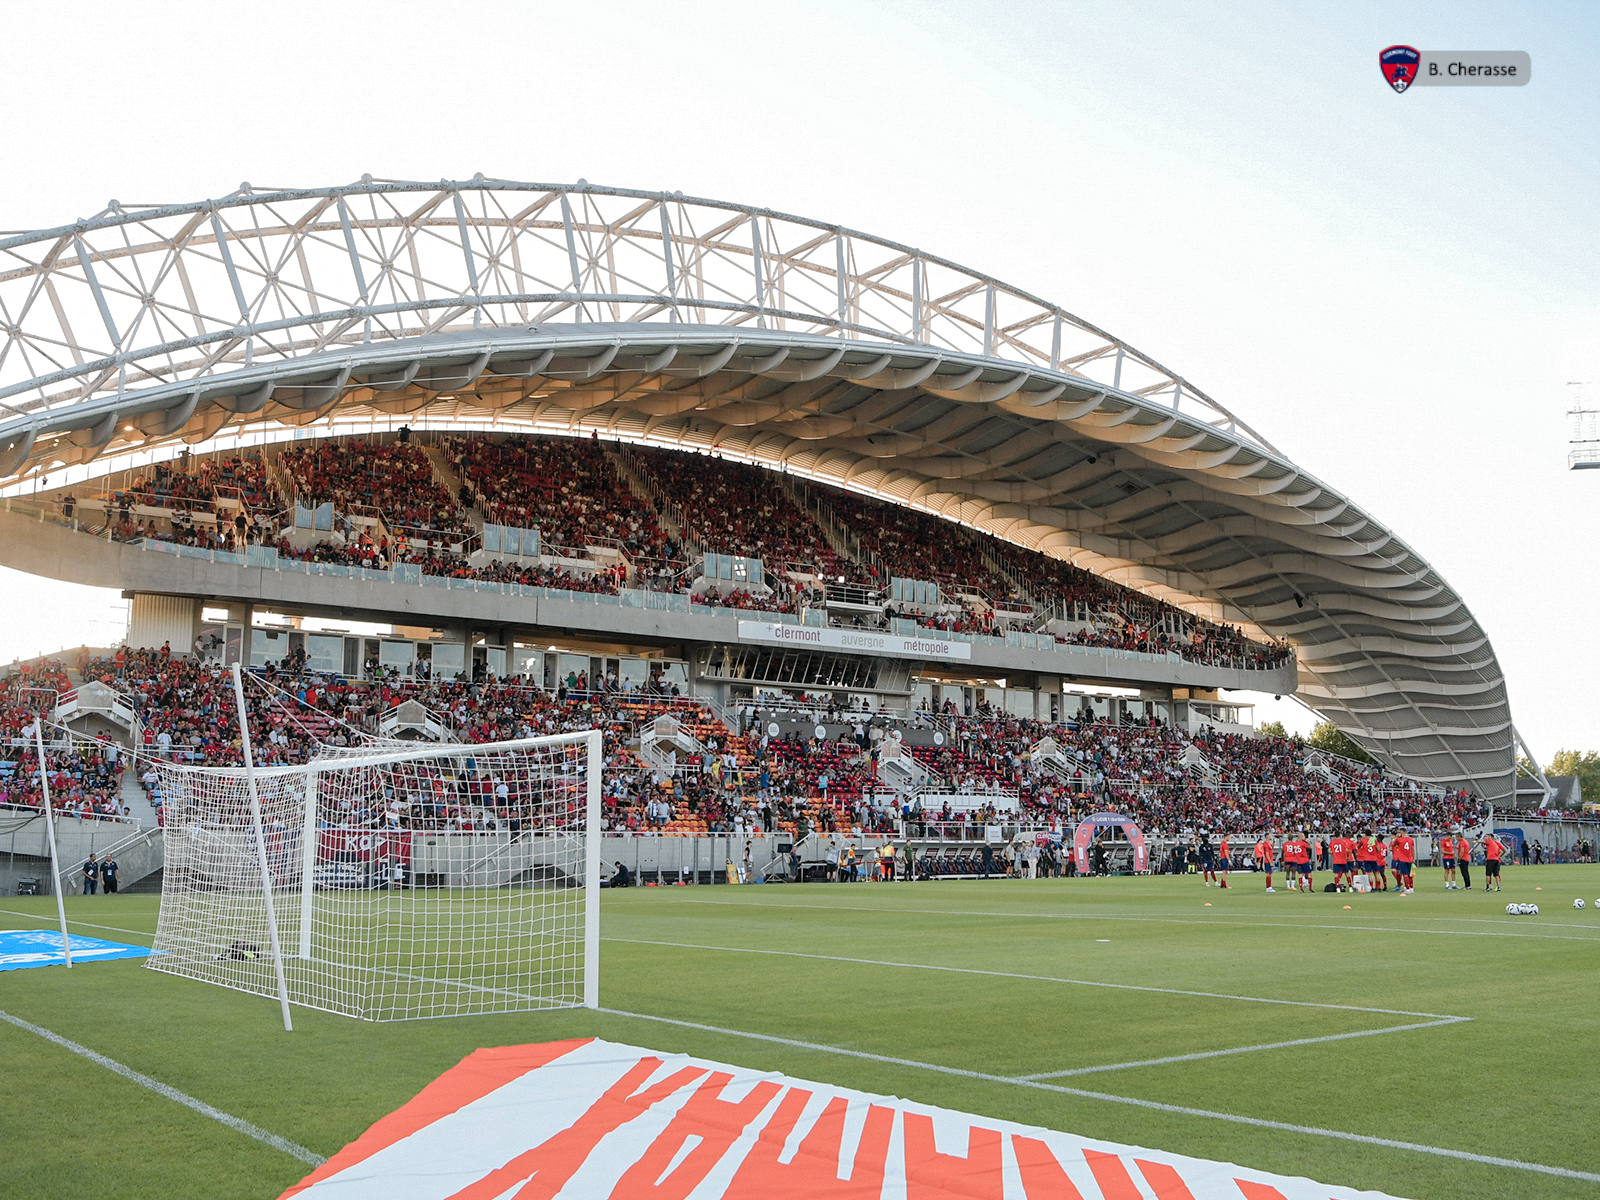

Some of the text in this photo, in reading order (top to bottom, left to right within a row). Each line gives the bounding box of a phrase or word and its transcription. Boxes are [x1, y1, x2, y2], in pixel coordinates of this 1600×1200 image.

[775, 626, 949, 655] clermont auvergne métropole
[1286, 844, 1293, 852] 19
[1334, 844, 1342, 853] 21
[1404, 842, 1409, 850] 4
